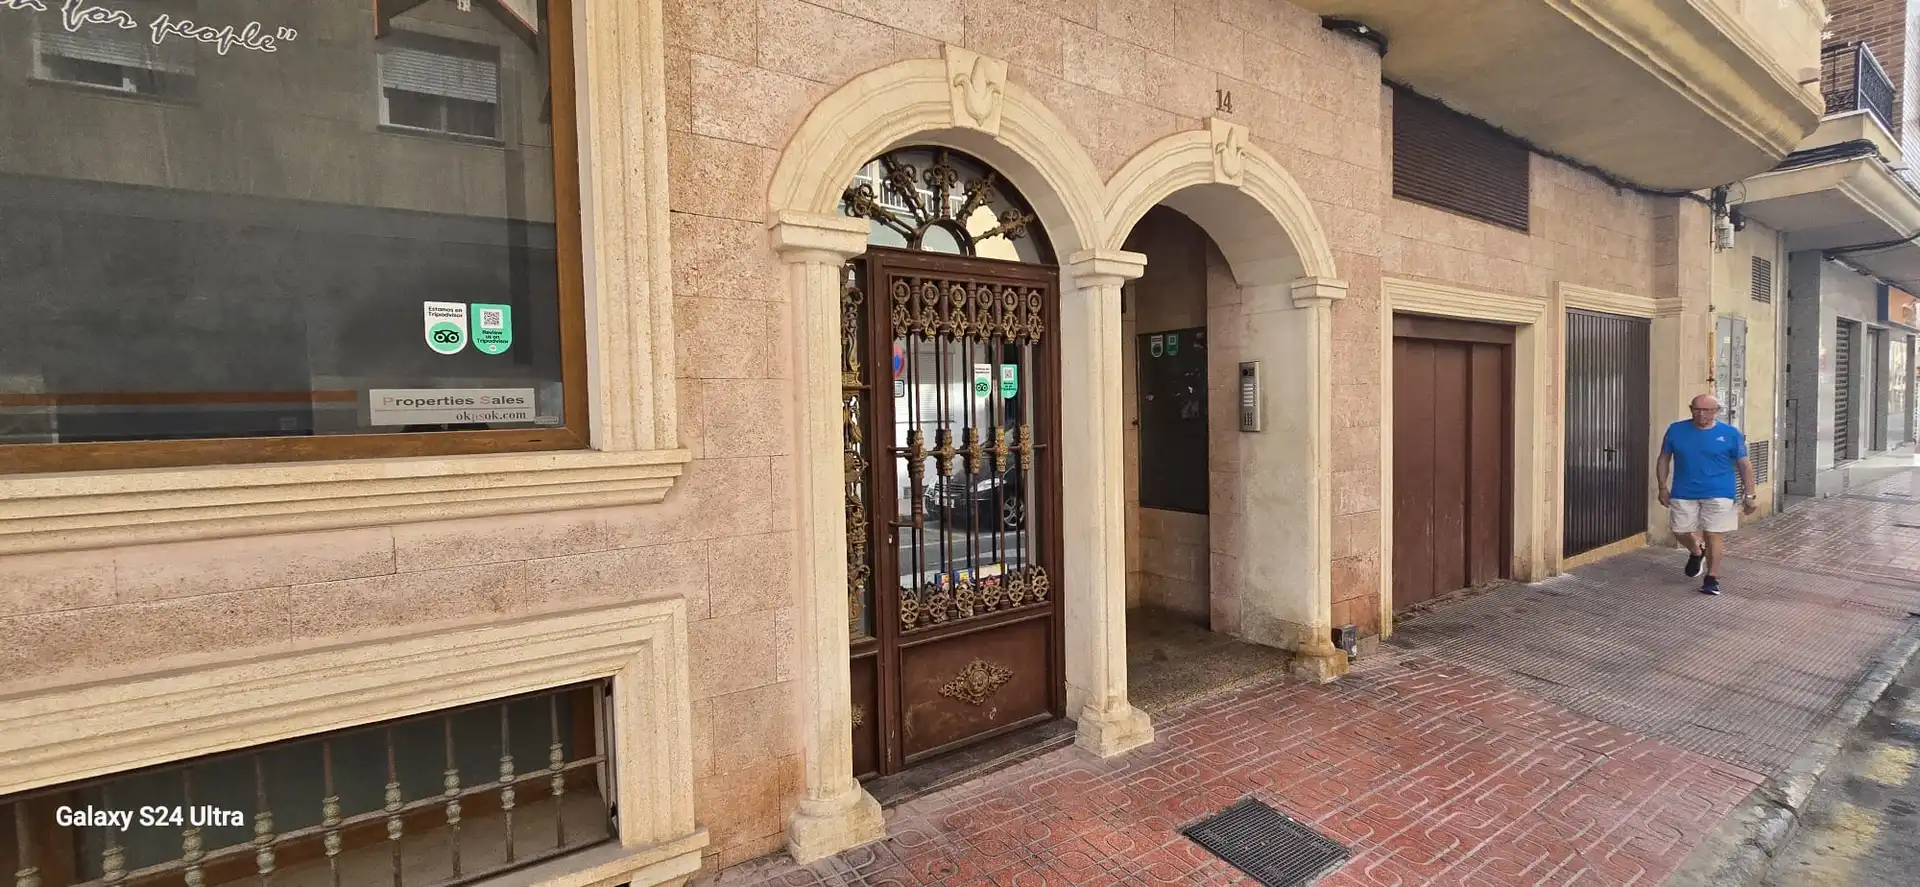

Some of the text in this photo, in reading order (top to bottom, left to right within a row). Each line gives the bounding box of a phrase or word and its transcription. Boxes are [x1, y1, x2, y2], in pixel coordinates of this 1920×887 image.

[61, 0, 138, 32] for
[1215, 89, 1233, 114] 14
[383, 396, 525, 407] Properties Sales
[456, 411, 527, 423] okpsok.com
